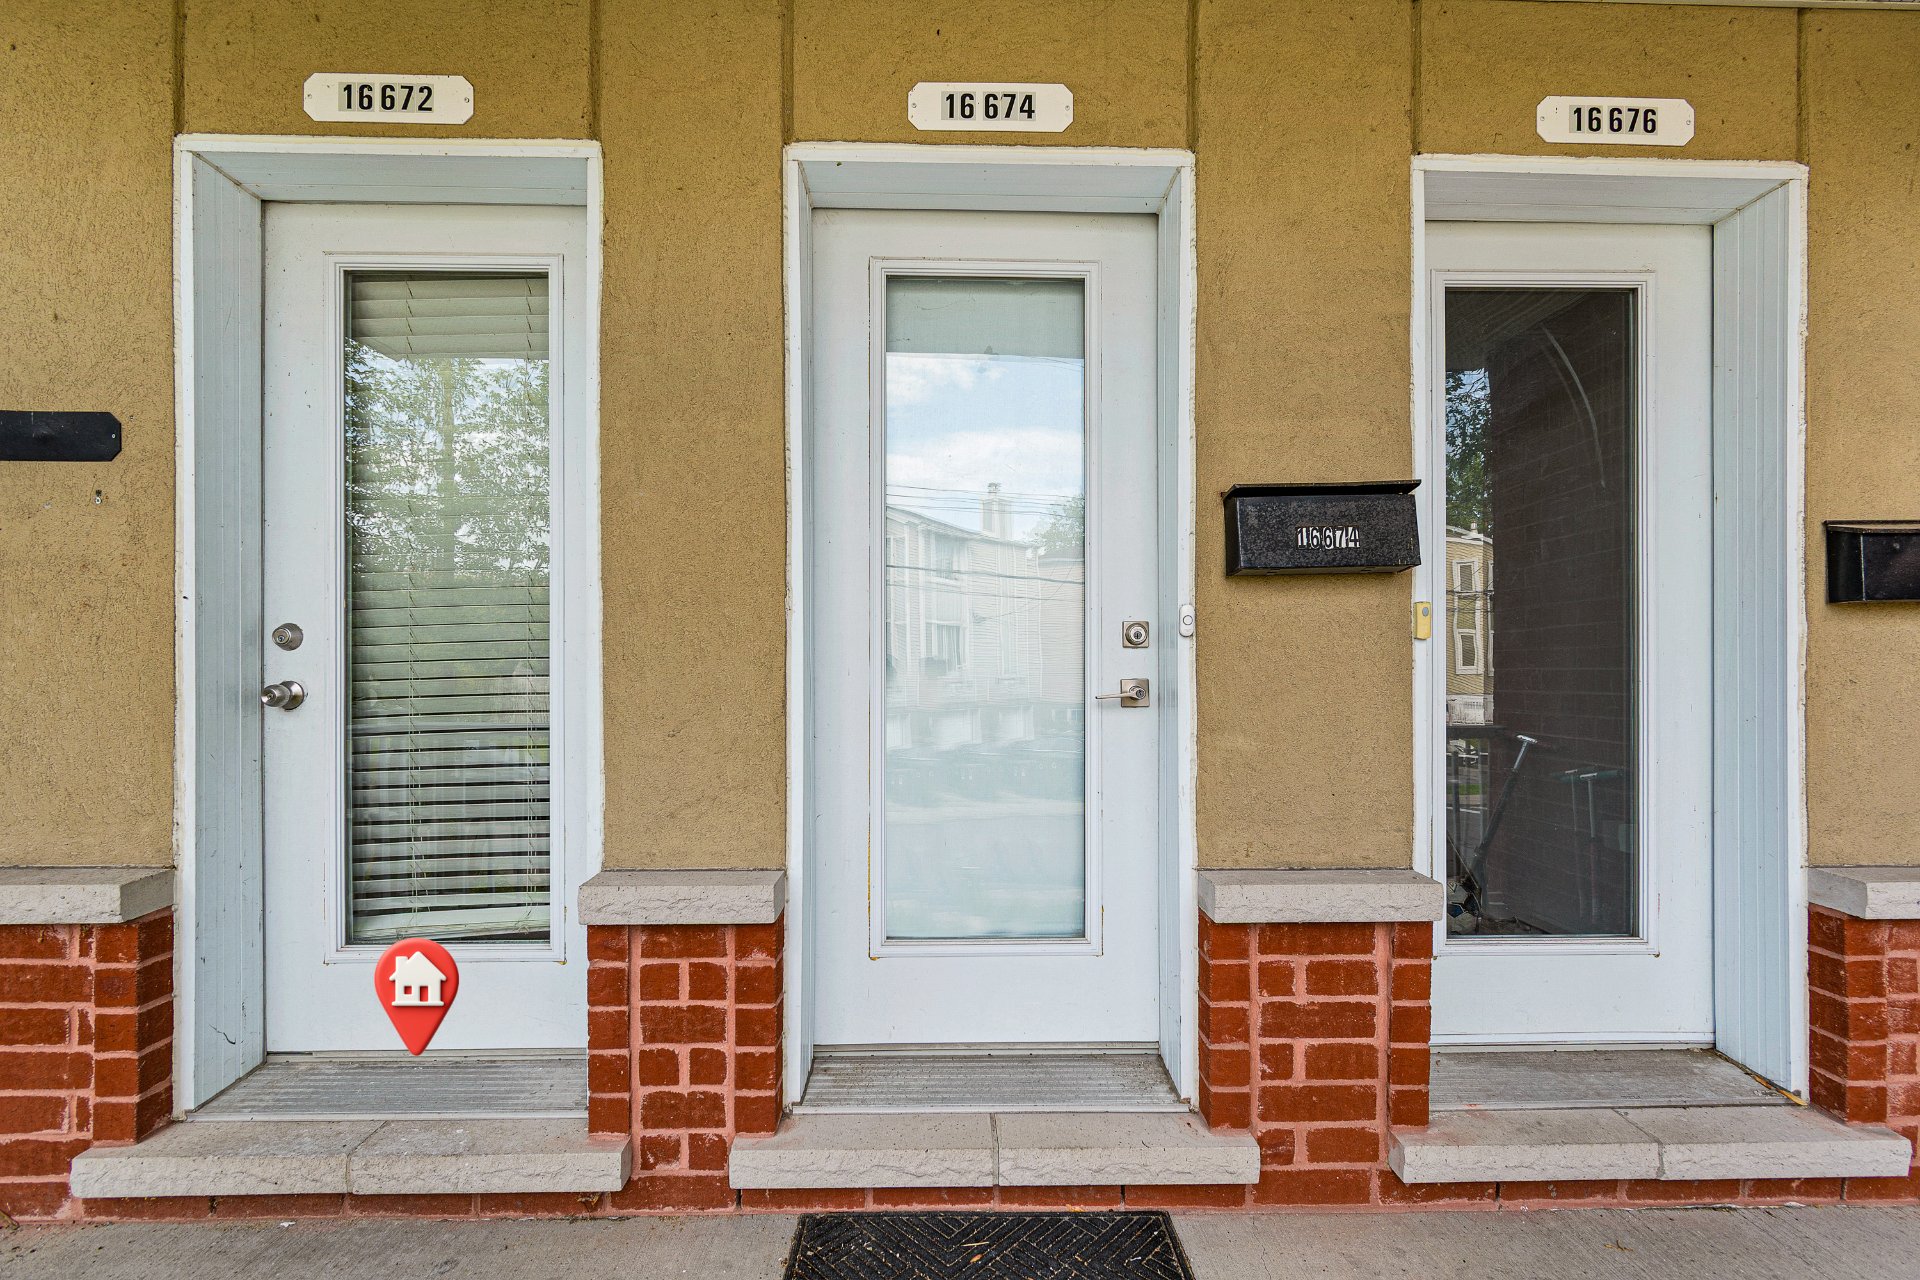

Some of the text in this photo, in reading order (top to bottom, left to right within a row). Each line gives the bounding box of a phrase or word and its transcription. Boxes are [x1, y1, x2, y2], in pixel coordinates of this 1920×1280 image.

[343, 84, 433, 111] 16672
[945, 93, 1035, 119] 16674
[1573, 106, 1657, 133] 16676
[1296, 526, 1361, 551] 16674
